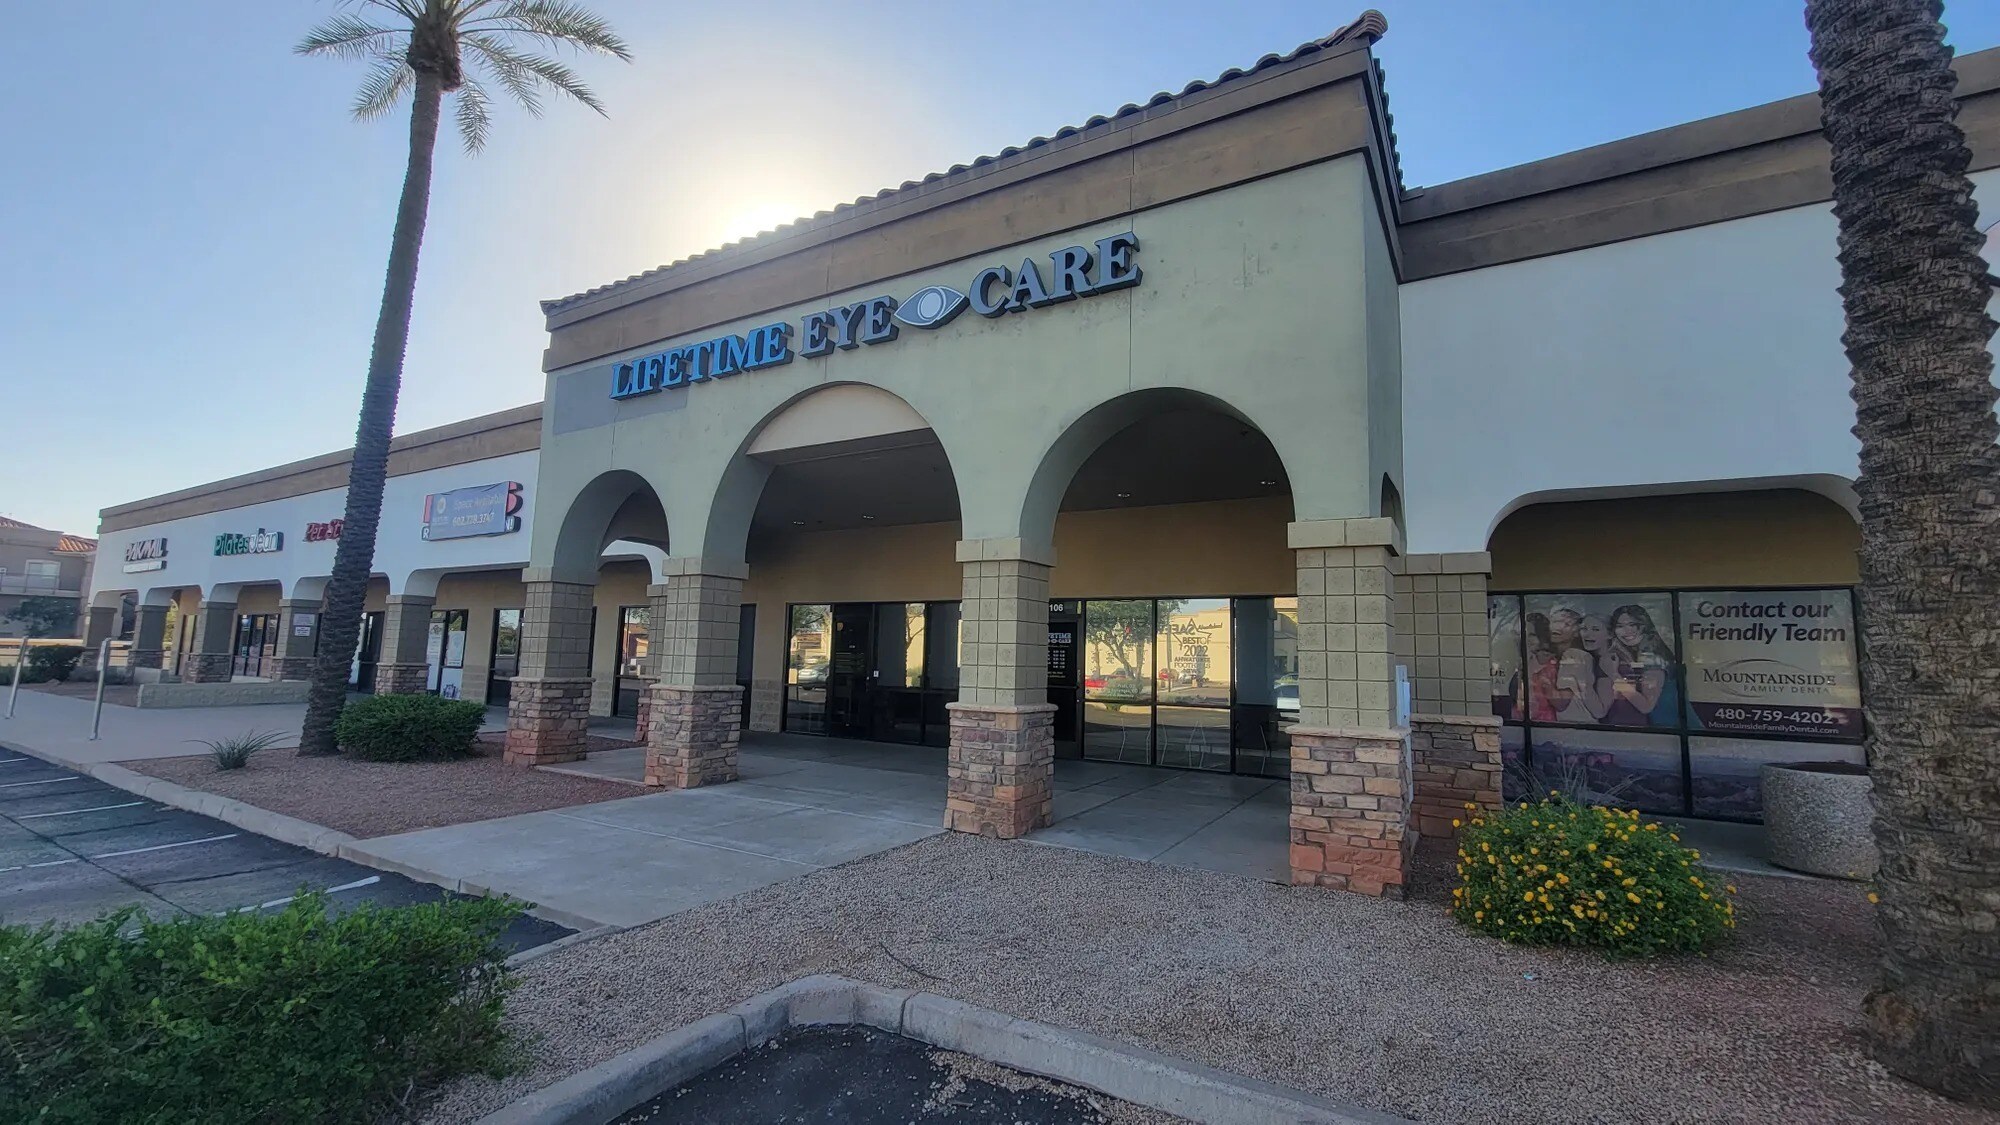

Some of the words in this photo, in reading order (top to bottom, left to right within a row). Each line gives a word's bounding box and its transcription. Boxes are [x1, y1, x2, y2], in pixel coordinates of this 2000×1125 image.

[610, 322, 794, 400] LIFETIME
[800, 295, 899, 360] EYE
[969, 231, 1143, 318] CARE
[1049, 603, 1064, 612] 106
[1697, 601, 1787, 618] Contact
[1791, 604, 1833, 618] our
[1688, 622, 1778, 644] Friendly
[1782, 623, 1846, 642] Team
[1182, 637, 1200, 645] BEST
[1184, 645, 1209, 657] 2022
[1743, 685, 1785, 693] FAMILY
[1791, 686, 1834, 694] DENTA
[1715, 708, 1834, 725] 480-759-4202
[1708, 721, 1840, 734] MountainsideFamilyDental.com
